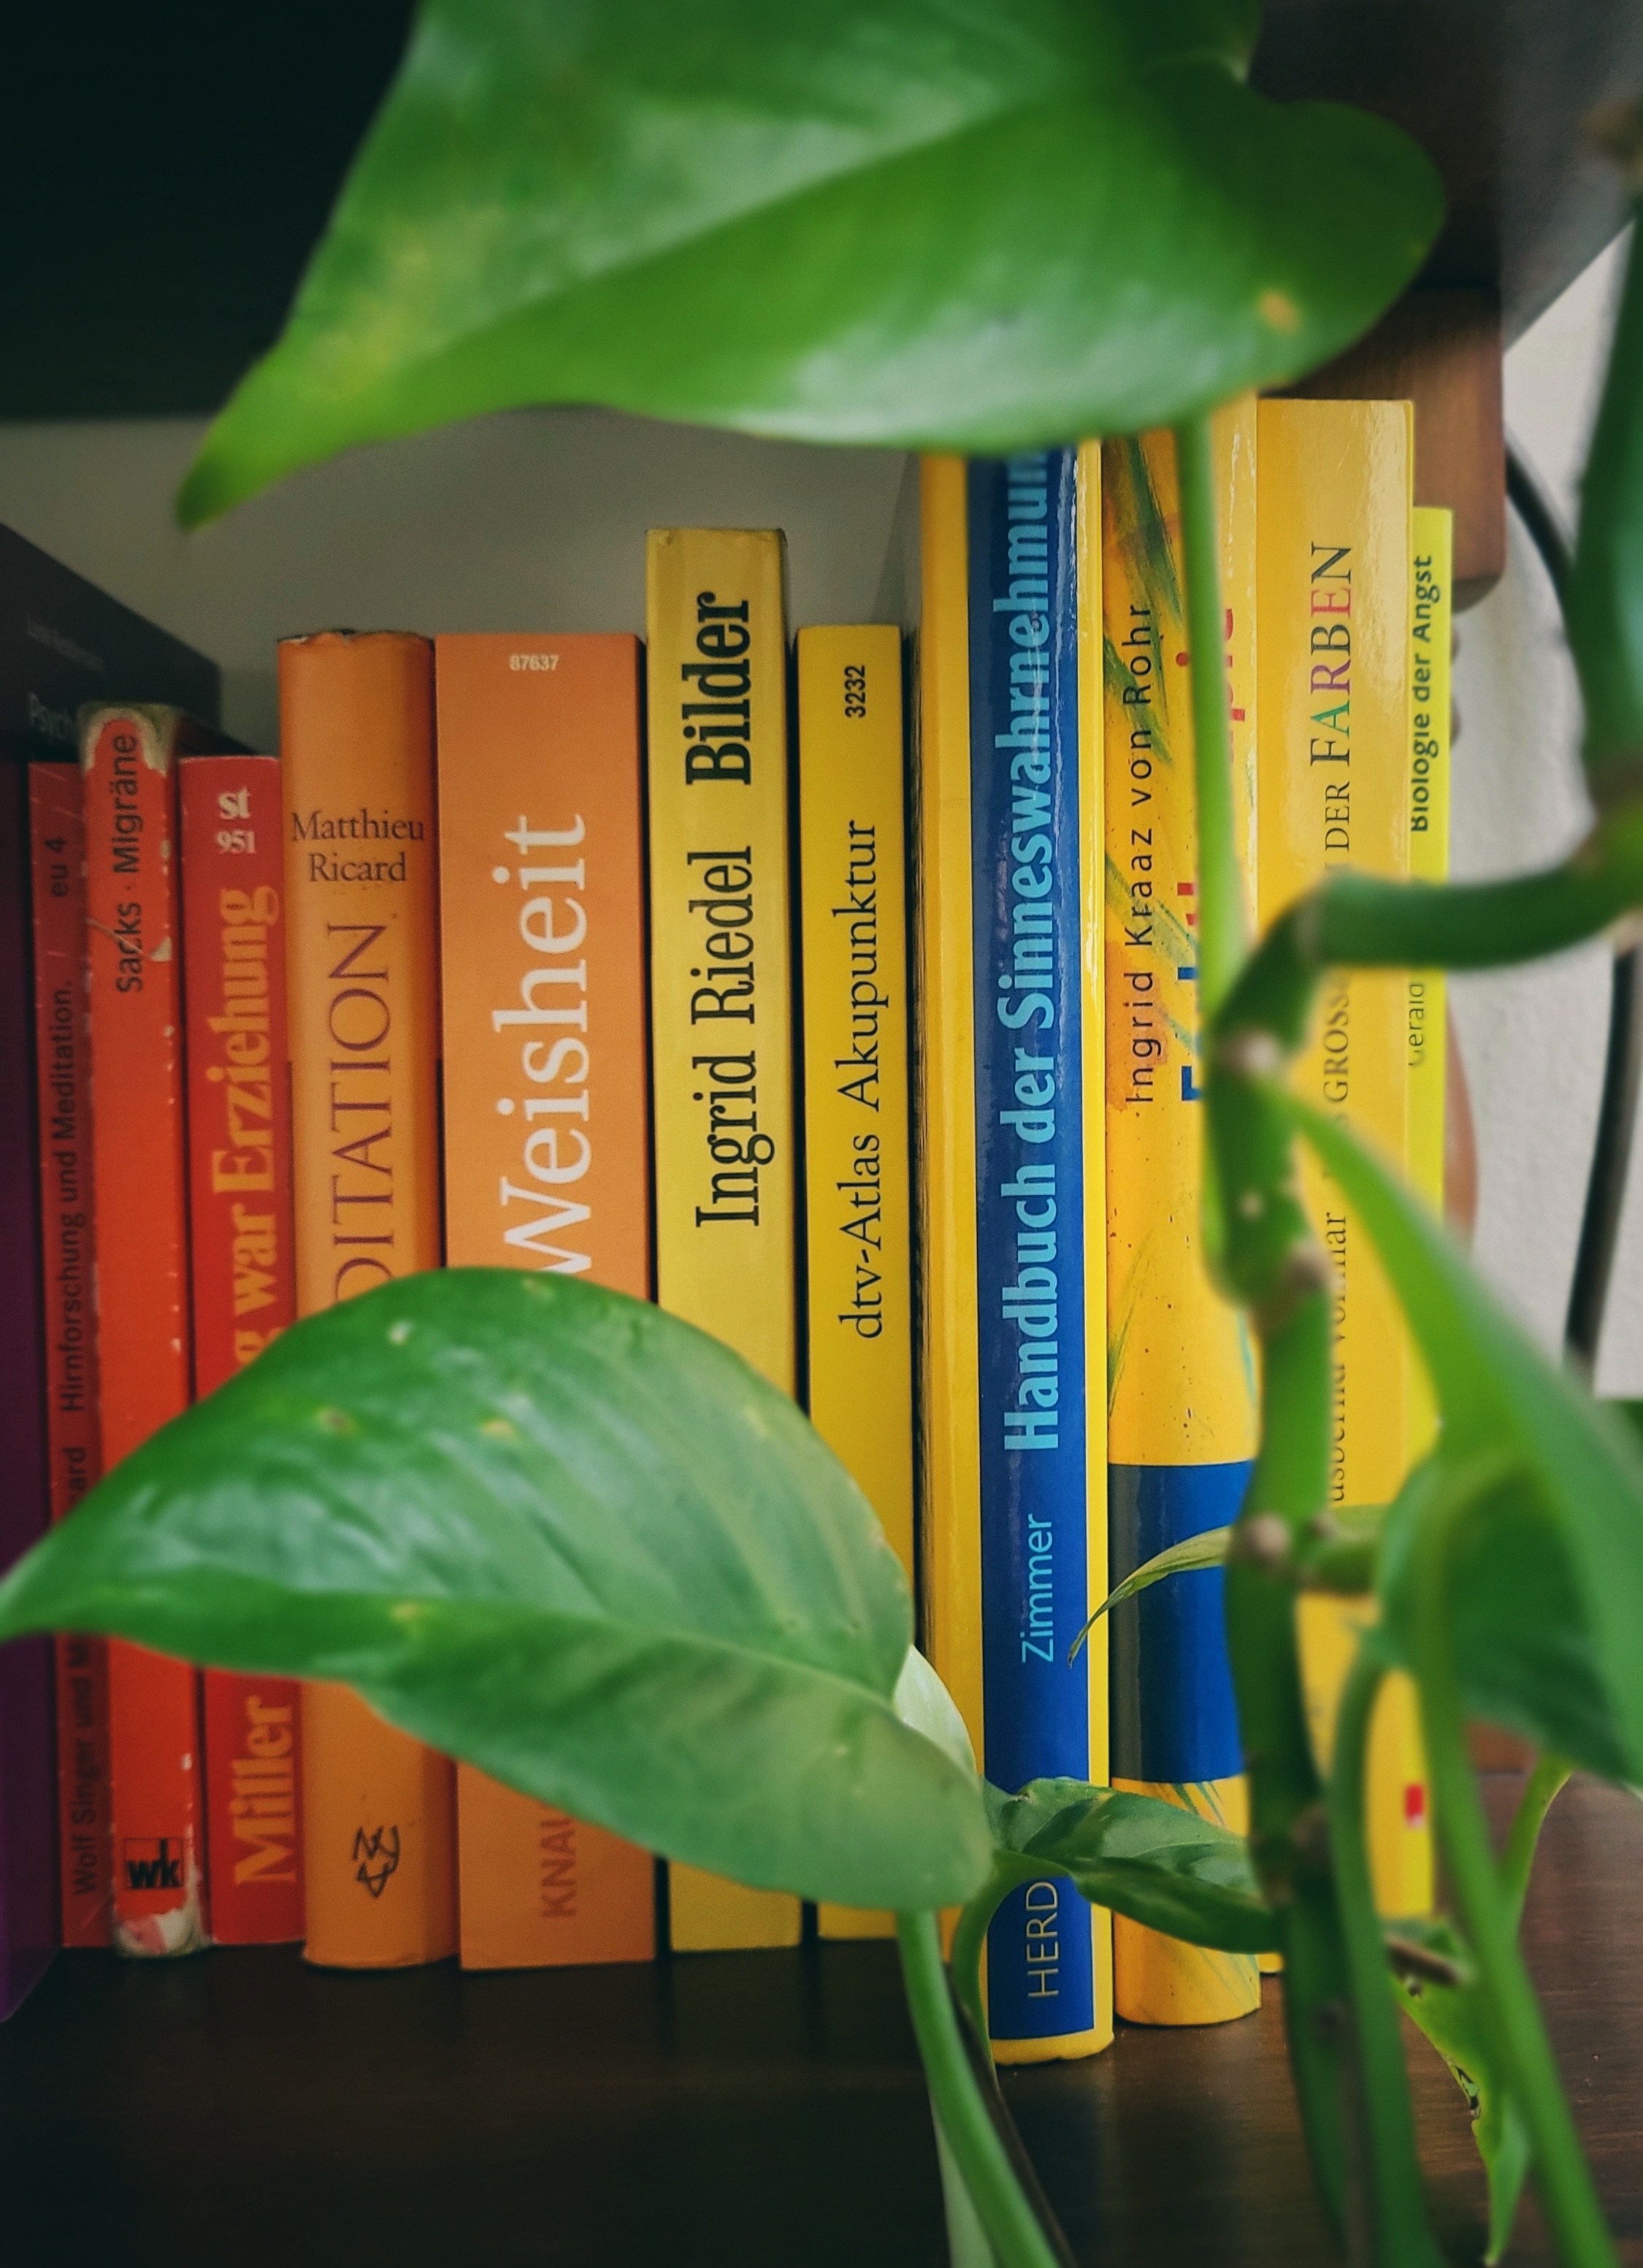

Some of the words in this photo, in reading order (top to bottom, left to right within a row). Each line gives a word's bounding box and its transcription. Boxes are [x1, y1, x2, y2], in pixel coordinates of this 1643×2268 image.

[1122, 605, 1152, 705] Rohr
[1310, 541, 1352, 767] FARBEN
[1412, 555, 1440, 642] Angst
[681, 591, 751, 785] Bilder
[844, 665, 866, 718] 3232
[1412, 654, 1431, 702] der
[110, 733, 143, 874] Migräne
[218, 786, 252, 820] st
[292, 810, 425, 841] Matthieu
[1130, 729, 1152, 807] von
[1325, 782, 1349, 852] DER
[1412, 714, 1438, 833] Biologie
[45, 836, 67, 854] 4
[51, 858, 69, 898] eu
[214, 830, 256, 855] 951
[309, 853, 407, 882] Ricard
[1125, 827, 1152, 947] Kraaz
[116, 902, 143, 993] Sacks
[687, 846, 756, 1026] Riedel
[832, 820, 889, 1112] Akupunktur
[51, 981, 75, 1141] Meditation.
[206, 885, 279, 1194] Erziehung
[1124, 971, 1162, 1104] Ingrid
[1322, 984, 1349, 1104] GROSS
[692, 1050, 775, 1228] Ingrid
[1000, 1049, 1056, 1143] der
[53, 1150, 79, 1202] und
[231, 1204, 278, 1316] war
[837, 1134, 883, 1339] dtv-Atlas
[56, 1210, 85, 1412] Hirnforschung
[1000, 1164, 1060, 1451] Handbuch
[61, 1447, 86, 1503] ard
[1021, 1513, 1054, 1664] Zimmer
[230, 1695, 296, 1886] Miller
[127, 1838, 180, 1889] wk
[1025, 1880, 1060, 1999] HERD
